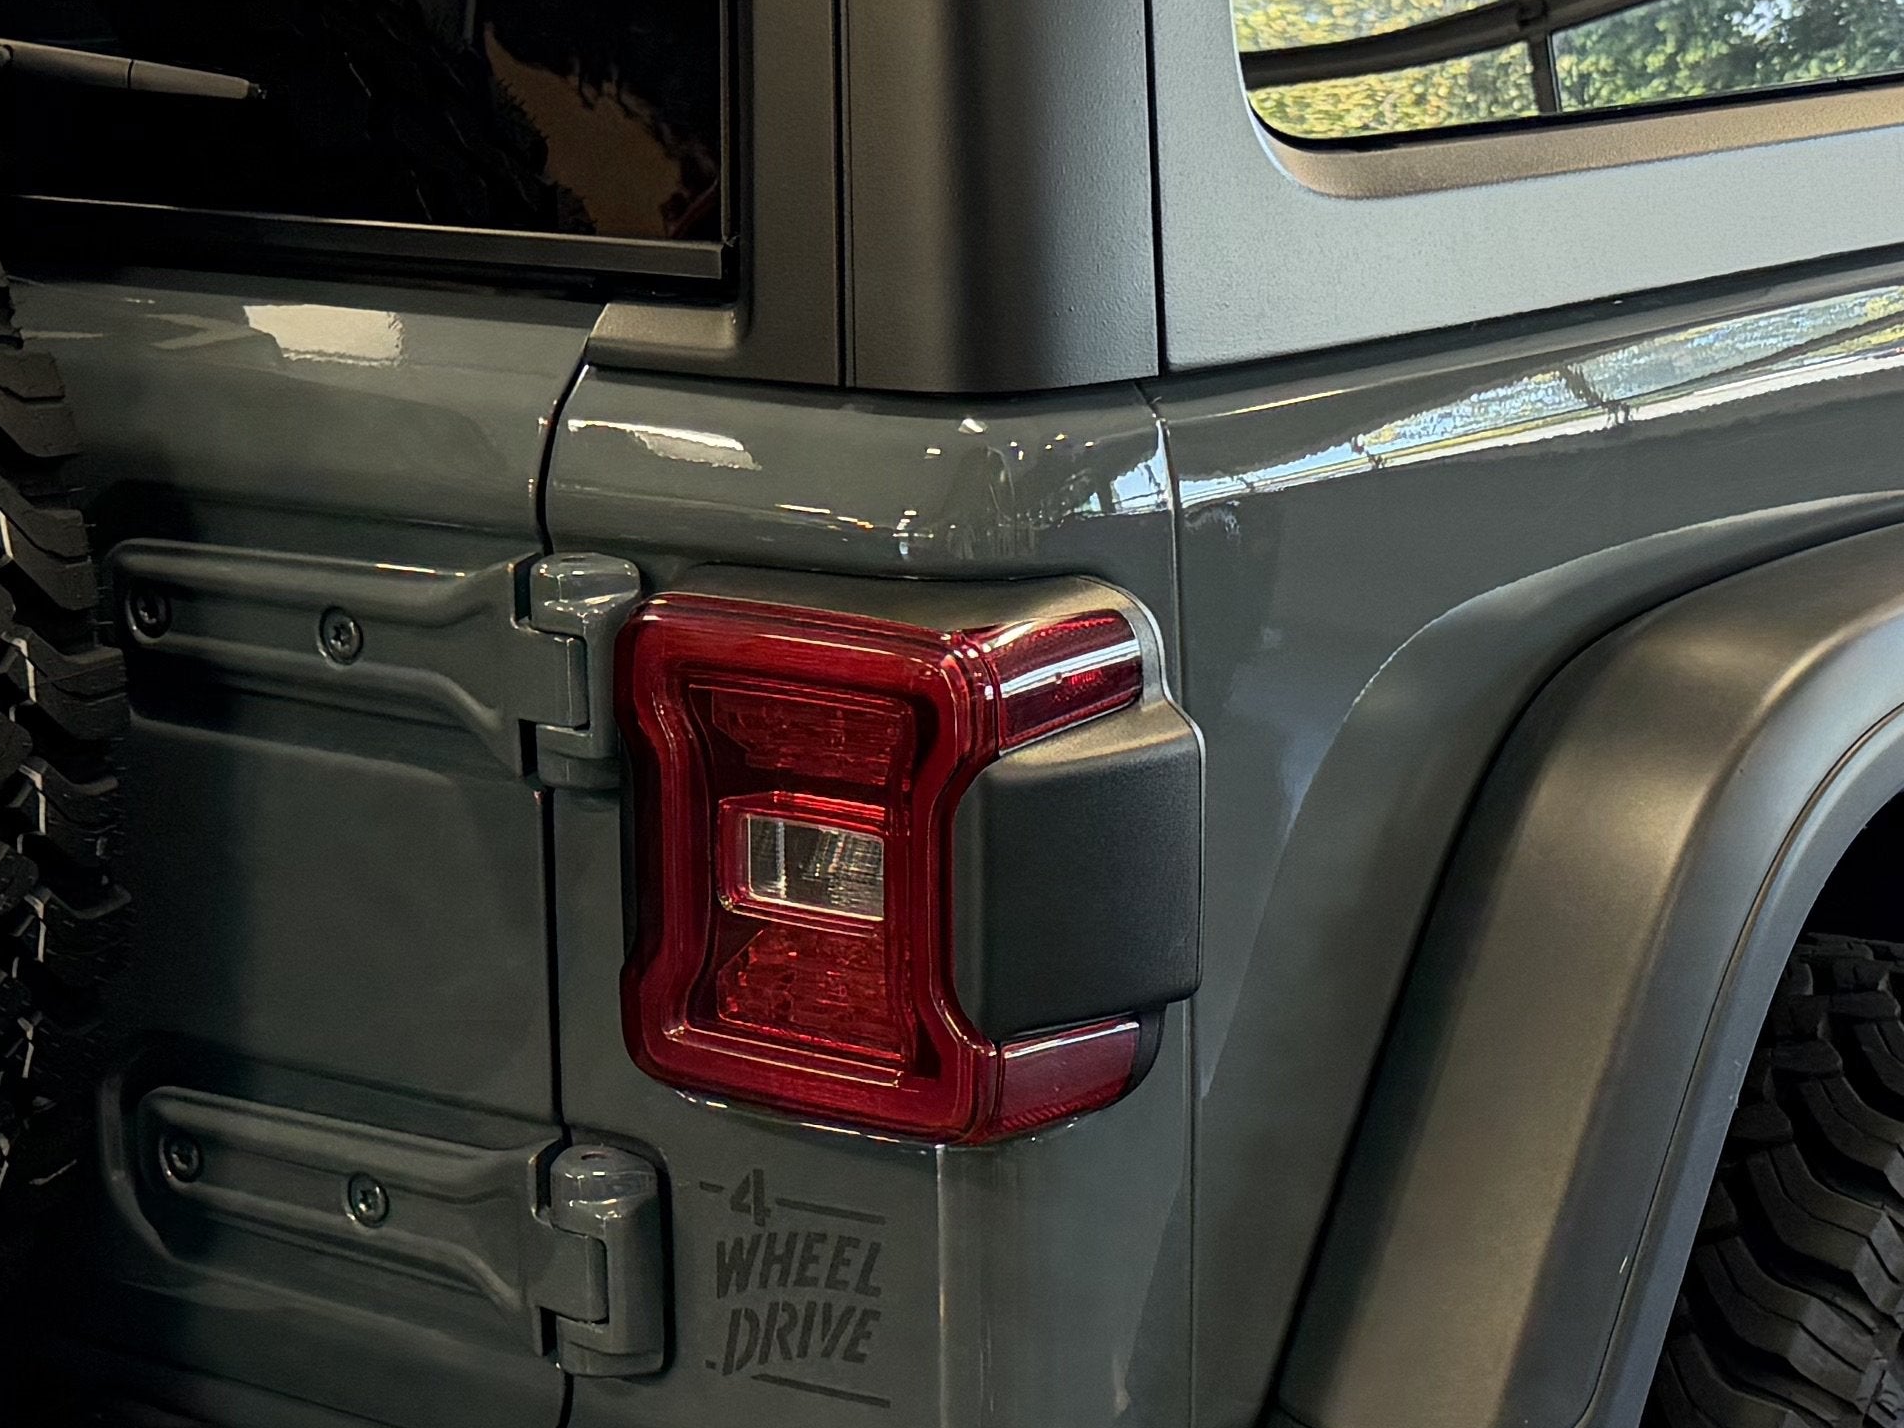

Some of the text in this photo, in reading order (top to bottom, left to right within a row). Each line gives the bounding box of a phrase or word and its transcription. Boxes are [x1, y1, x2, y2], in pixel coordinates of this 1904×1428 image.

[728, 1168, 772, 1228] 4
[715, 1230, 883, 1300] WHEEL
[721, 1299, 883, 1377] DRIVE
